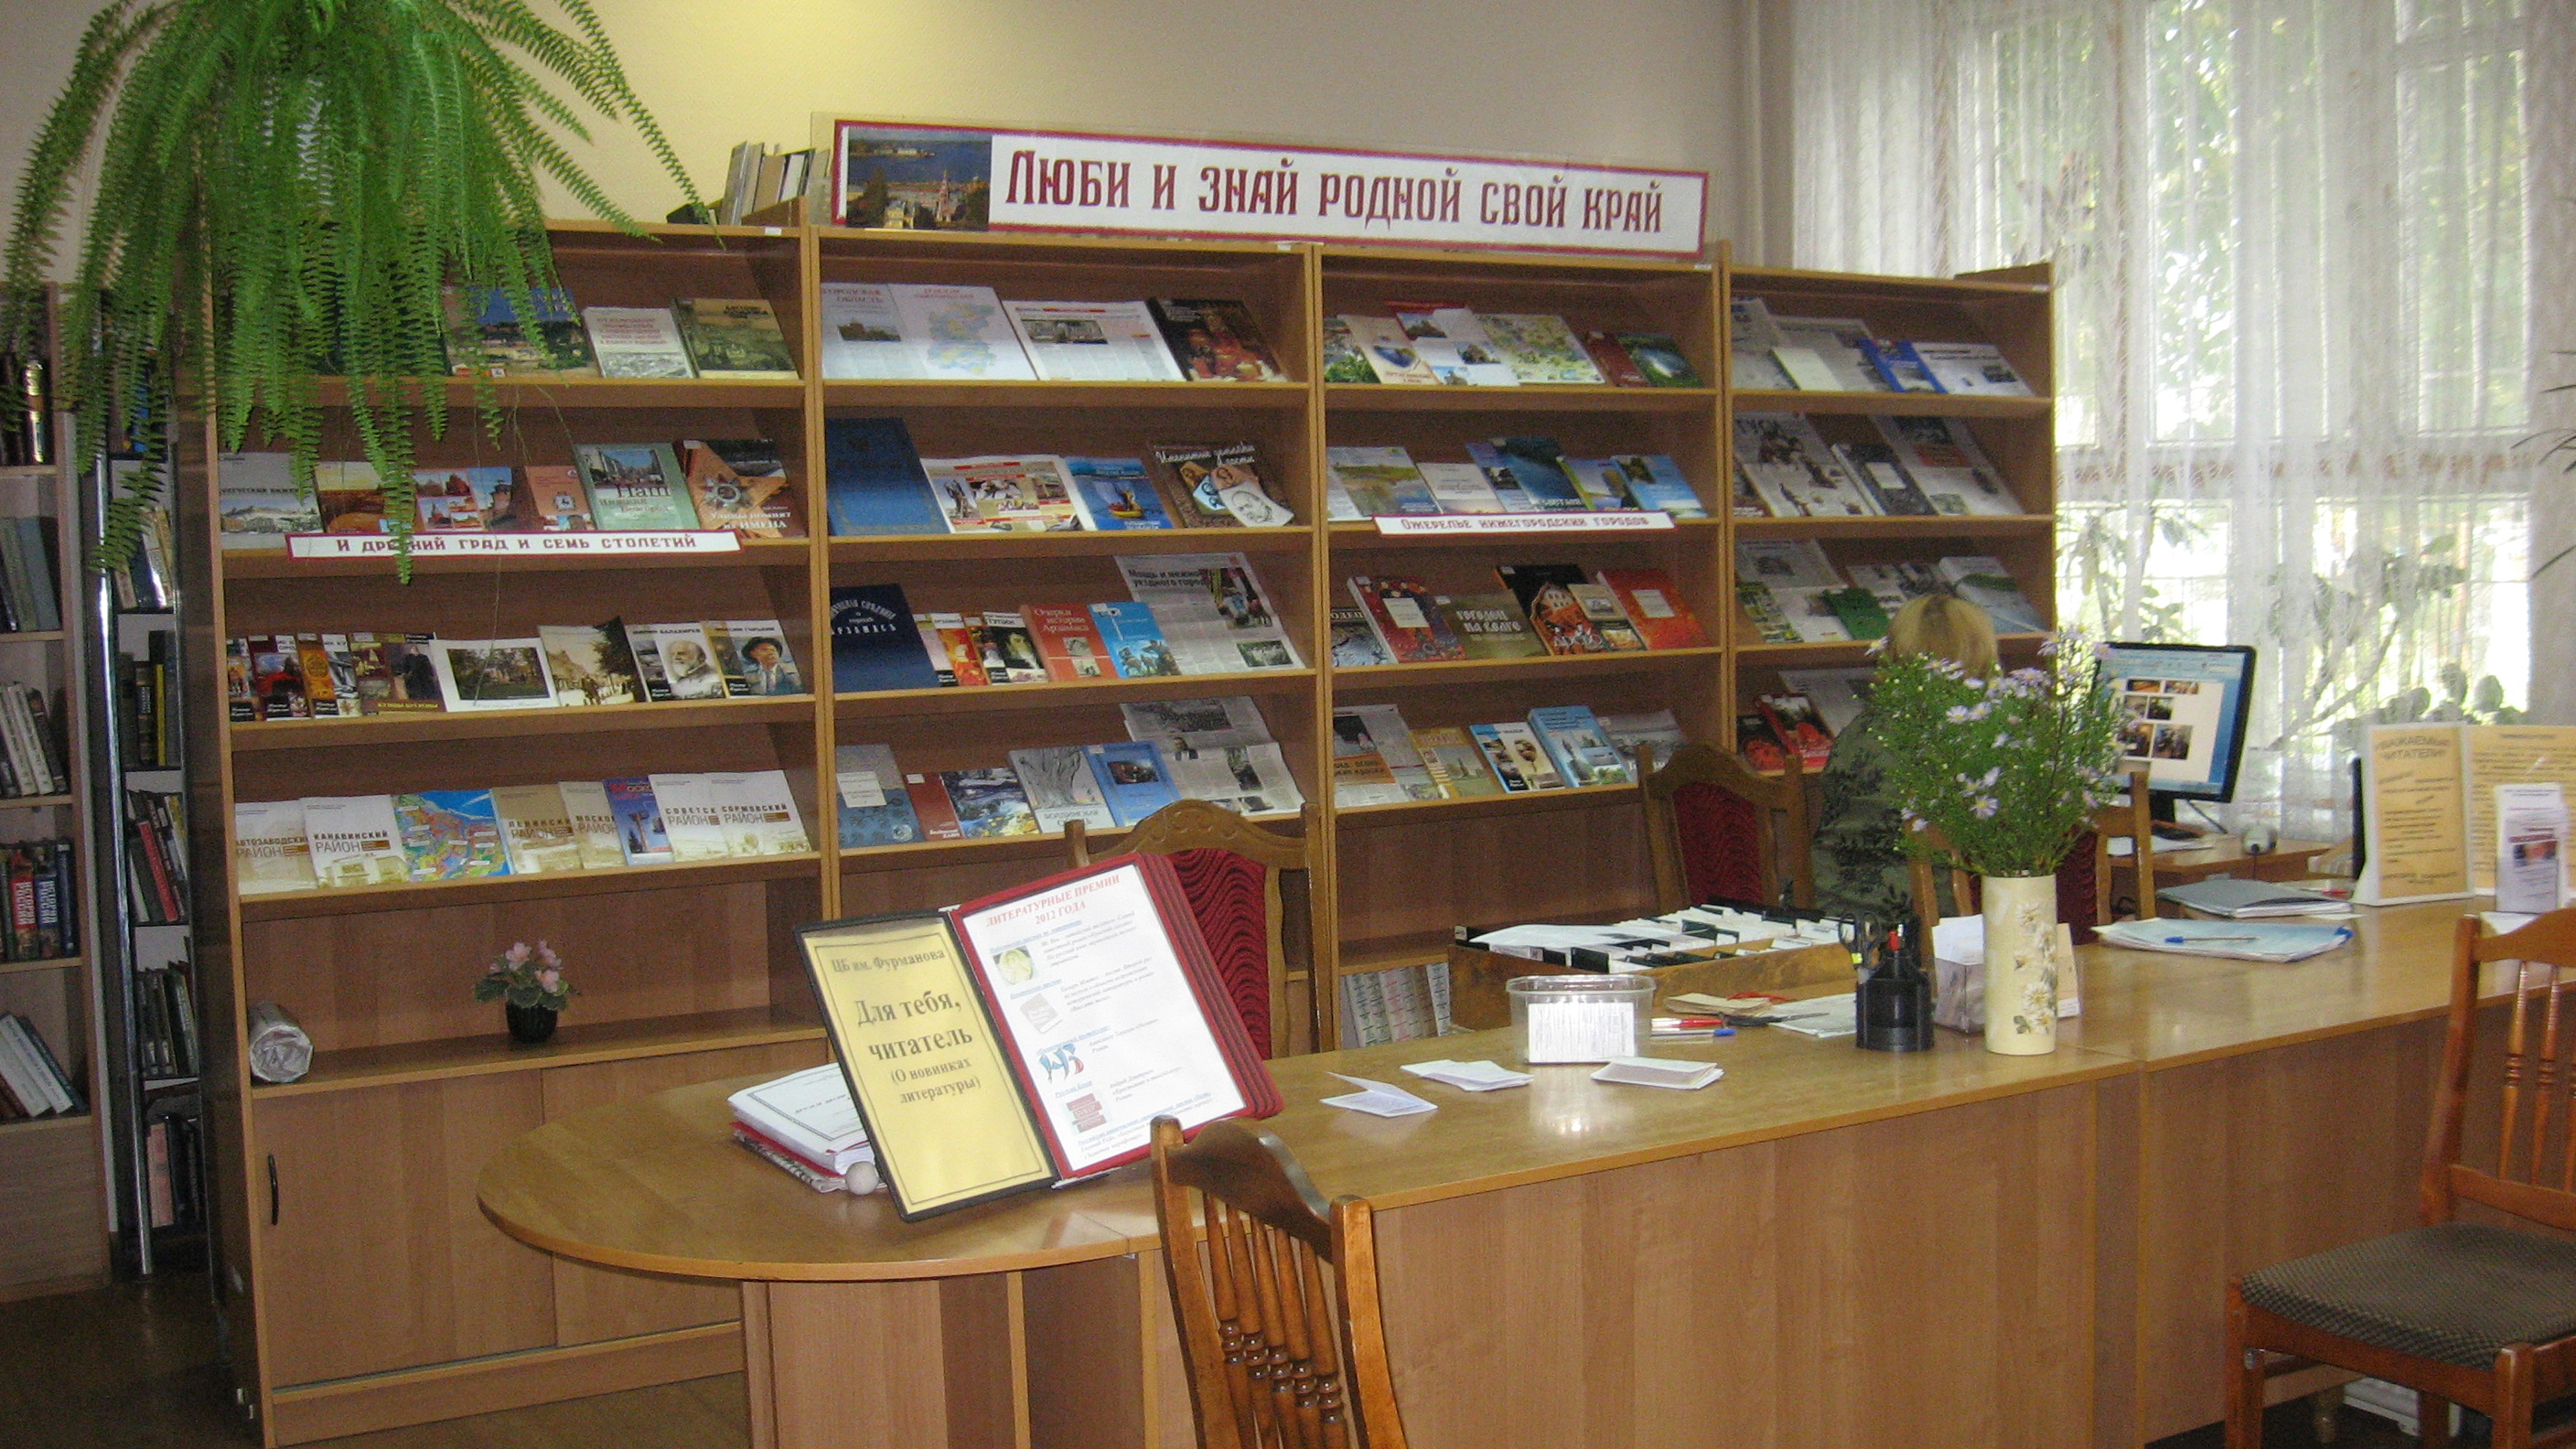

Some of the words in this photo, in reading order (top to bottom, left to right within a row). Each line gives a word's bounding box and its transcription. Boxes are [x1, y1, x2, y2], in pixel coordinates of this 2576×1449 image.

[1005, 149, 1131, 209] ЛЮБИ
[1152, 163, 1177, 210] И
[1197, 156, 1299, 215] ЗНАЙ
[1317, 166, 1463, 231] РОДНОЙ
[1479, 174, 1568, 229] СВОЙ
[1581, 178, 1664, 233] КРАЙ
[337, 538, 350, 552] И
[361, 536, 446, 553] ДРЕНИЙ
[458, 538, 509, 552] ГРАД
[518, 538, 531, 549] И
[542, 538, 590, 550] СЕМЬ
[601, 533, 697, 549] СТОЛЕТИЙ
[665, 807, 717, 815] СОВЕТСК
[667, 815, 709, 826] РАЙОН
[724, 812, 765, 824] РАЙОН
[235, 835, 308, 847] АВТОЗАВОДСКИ
[313, 829, 389, 841] КАНАВИНСКИЙ
[315, 841, 361, 853] РАЙОН
[985, 890, 1073, 928] ЛИТЕРАТУРНЫЕ
[1074, 874, 1121, 897] ПРЕМИИ
[1034, 909, 1057, 926] 2012
[1057, 899, 1087, 918] ГОДА
[831, 959, 851, 972] ЦБ
[853, 960, 873, 971] им.
[873, 950, 946, 971] Фурманова
[854, 1000, 897, 1028] Для
[900, 989, 961, 1018] тебя,
[868, 1027, 974, 1061] читатель
[890, 1067, 907, 1086] (О
[909, 1057, 972, 1080] новинках
[899, 1075, 982, 1104] литературы)
